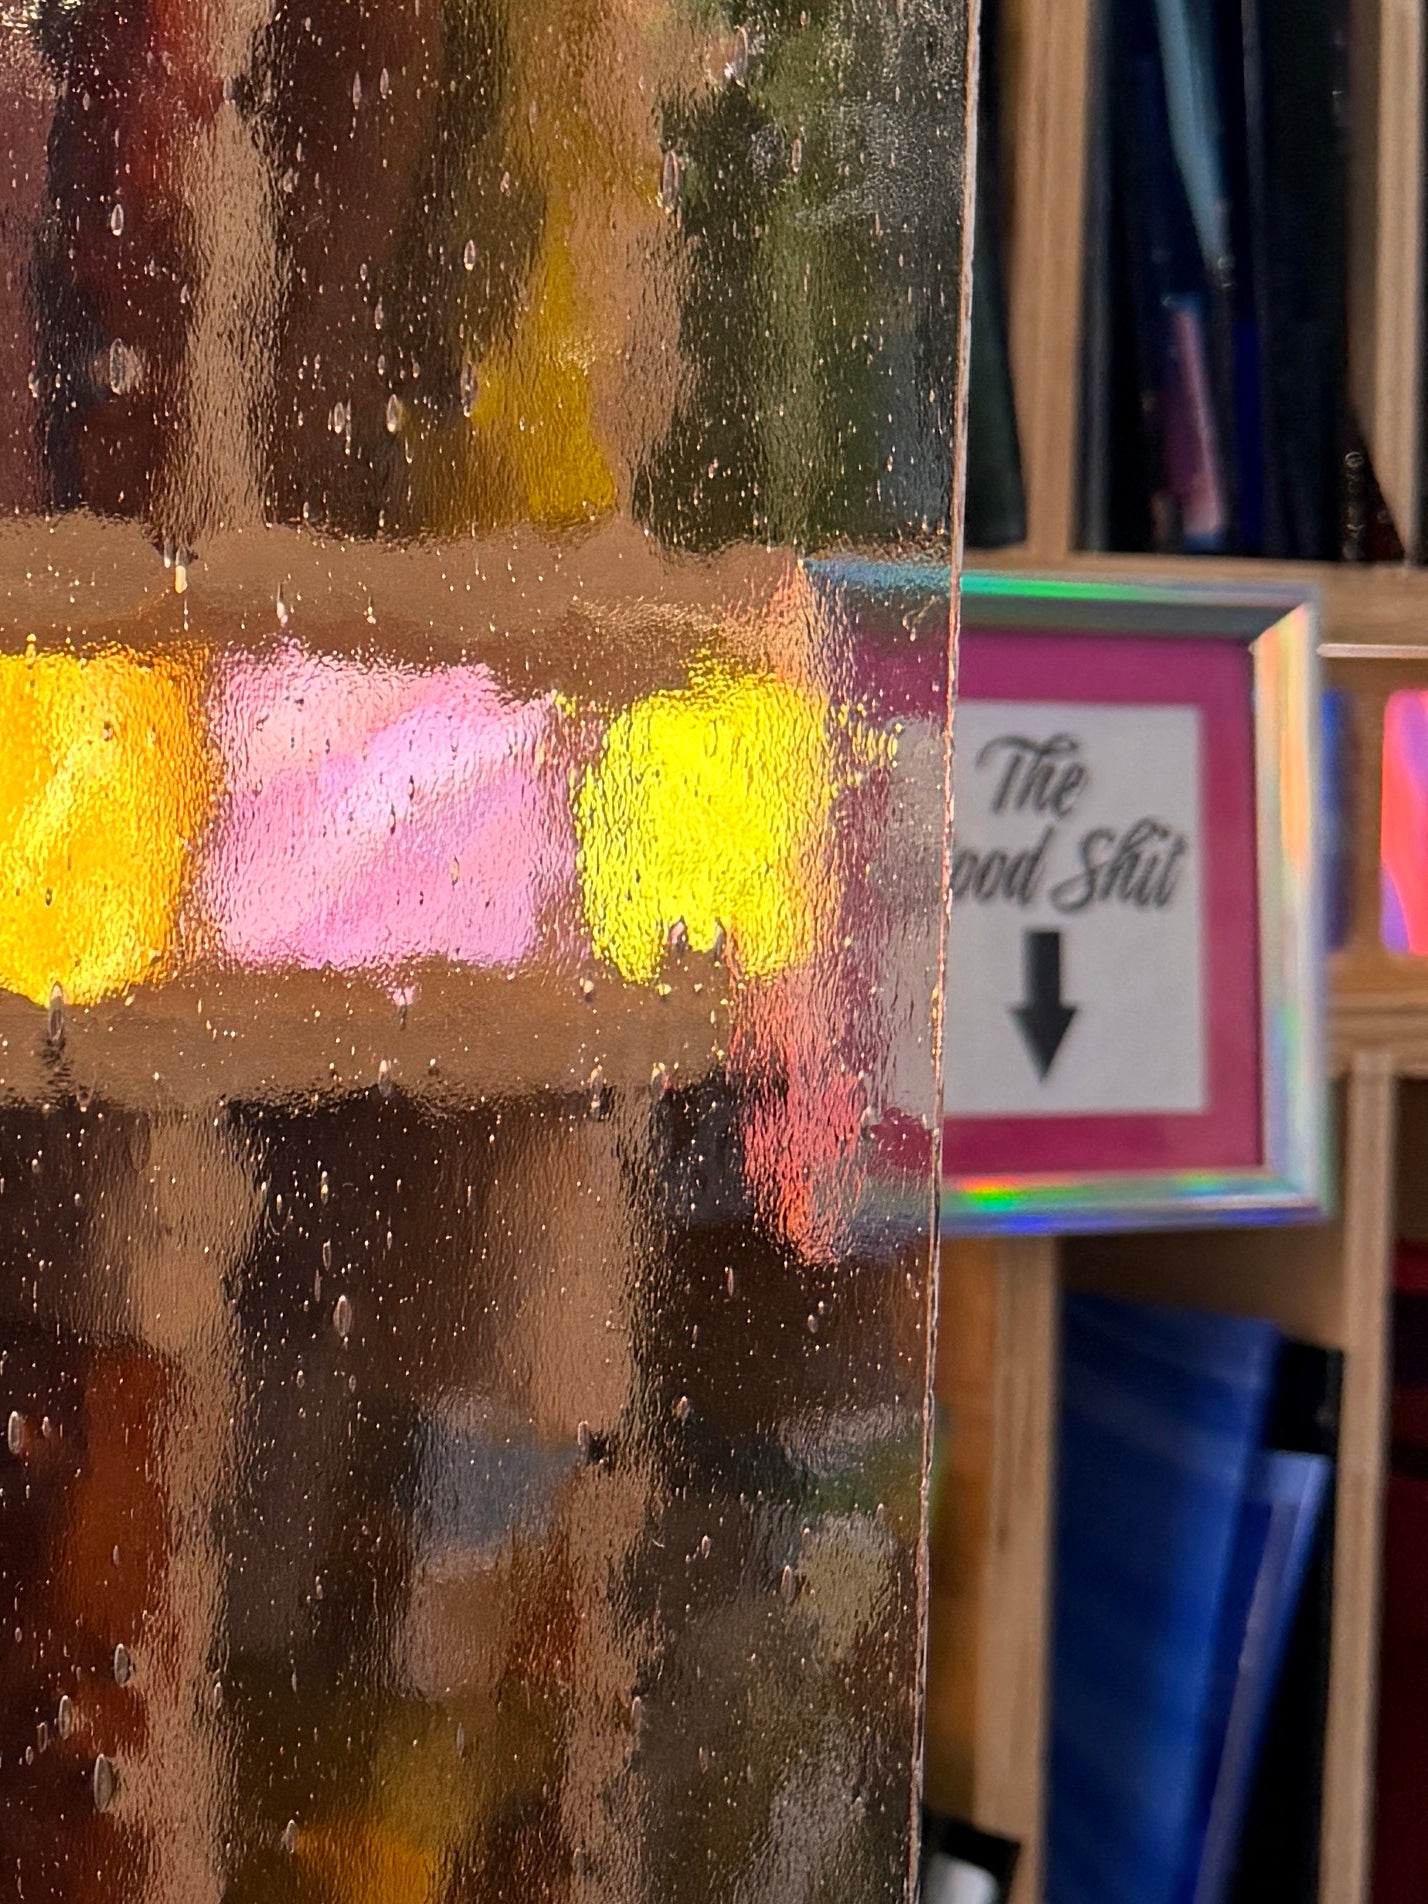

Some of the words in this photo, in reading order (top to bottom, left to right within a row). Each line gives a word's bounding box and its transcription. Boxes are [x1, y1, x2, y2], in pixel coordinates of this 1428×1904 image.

[975, 732, 1088, 820] The
[952, 825, 1055, 909] ood
[1047, 817, 1188, 914] Shit
